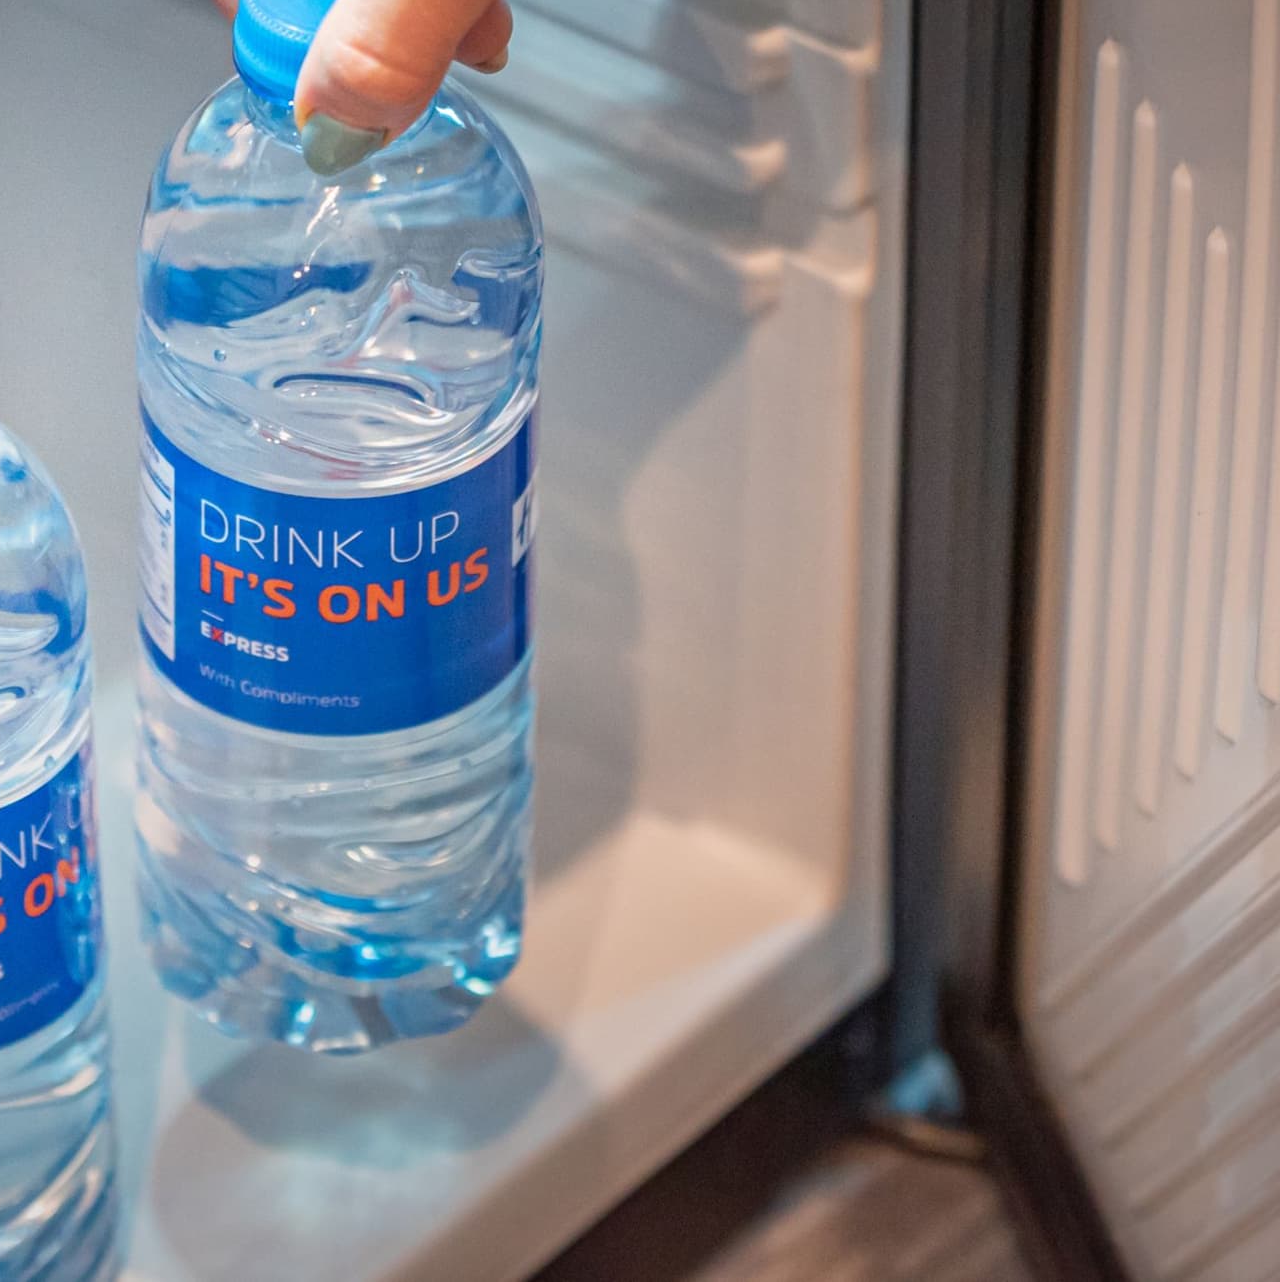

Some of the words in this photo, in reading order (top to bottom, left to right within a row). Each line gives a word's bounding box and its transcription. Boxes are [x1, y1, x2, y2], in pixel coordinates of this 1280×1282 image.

[200, 499, 364, 569] DRINK
[389, 510, 461, 564] UP
[200, 554, 297, 619] IT'S
[318, 579, 406, 624] ON
[427, 547, 490, 607] US
[200, 622, 290, 663] EXPRESS
[200, 663, 236, 690] With
[240, 679, 361, 709] Compliments
[23, 846, 81, 919] ON
